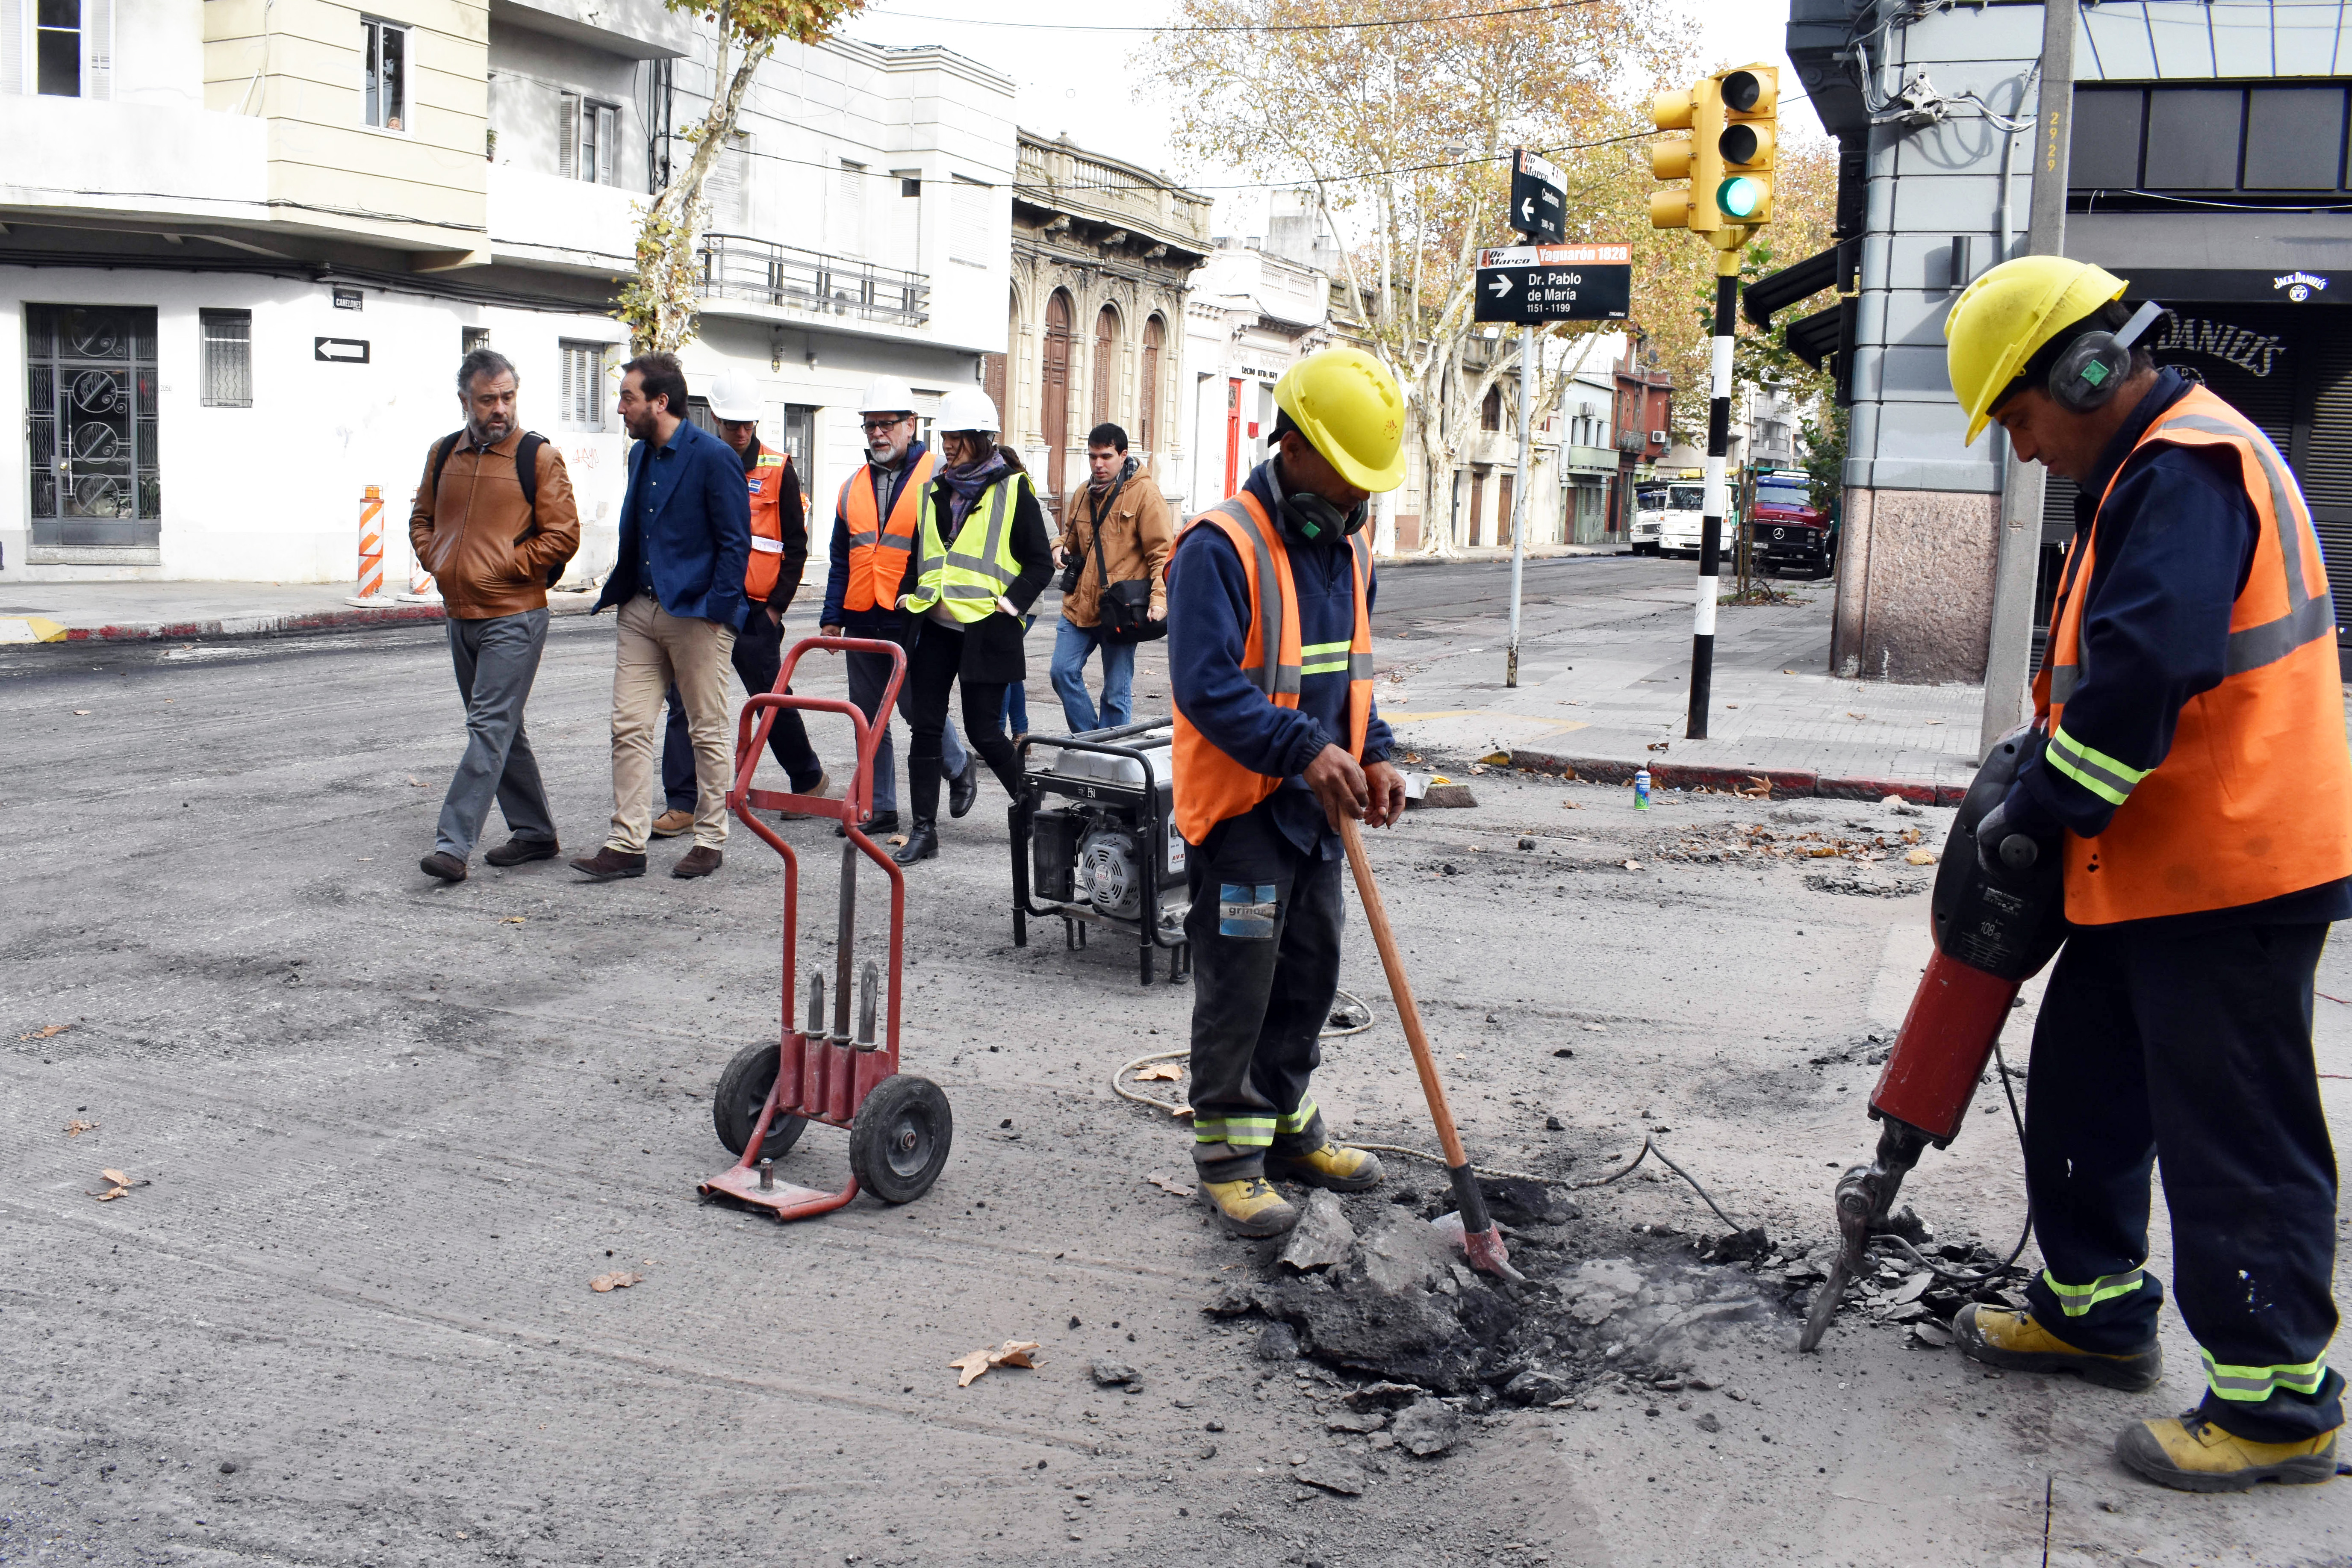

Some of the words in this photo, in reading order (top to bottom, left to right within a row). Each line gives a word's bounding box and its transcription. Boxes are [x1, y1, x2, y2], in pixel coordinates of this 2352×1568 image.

[1526, 153, 1535, 165] De
[1526, 165, 1548, 182] Marco
[1542, 188, 1559, 208] Canelones
[1539, 247, 1595, 262] Yaguarón
[1597, 246, 1627, 260] 1828
[1529, 274, 1544, 286] Dr.
[1548, 272, 1581, 285] Pablo
[2274, 275, 2294, 289] JACK
[2295, 272, 2327, 290] DANIEL'S
[1528, 289, 1541, 301] de
[1544, 288, 1576, 301] María
[336, 298, 361, 308] CANELONES
[1527, 304, 1542, 312] 1151
[1551, 304, 1570, 312] 1199
[1242, 365, 1255, 375] tecno
[1258, 369, 1278, 381] uruguay
[1981, 921, 1995, 936] 108
